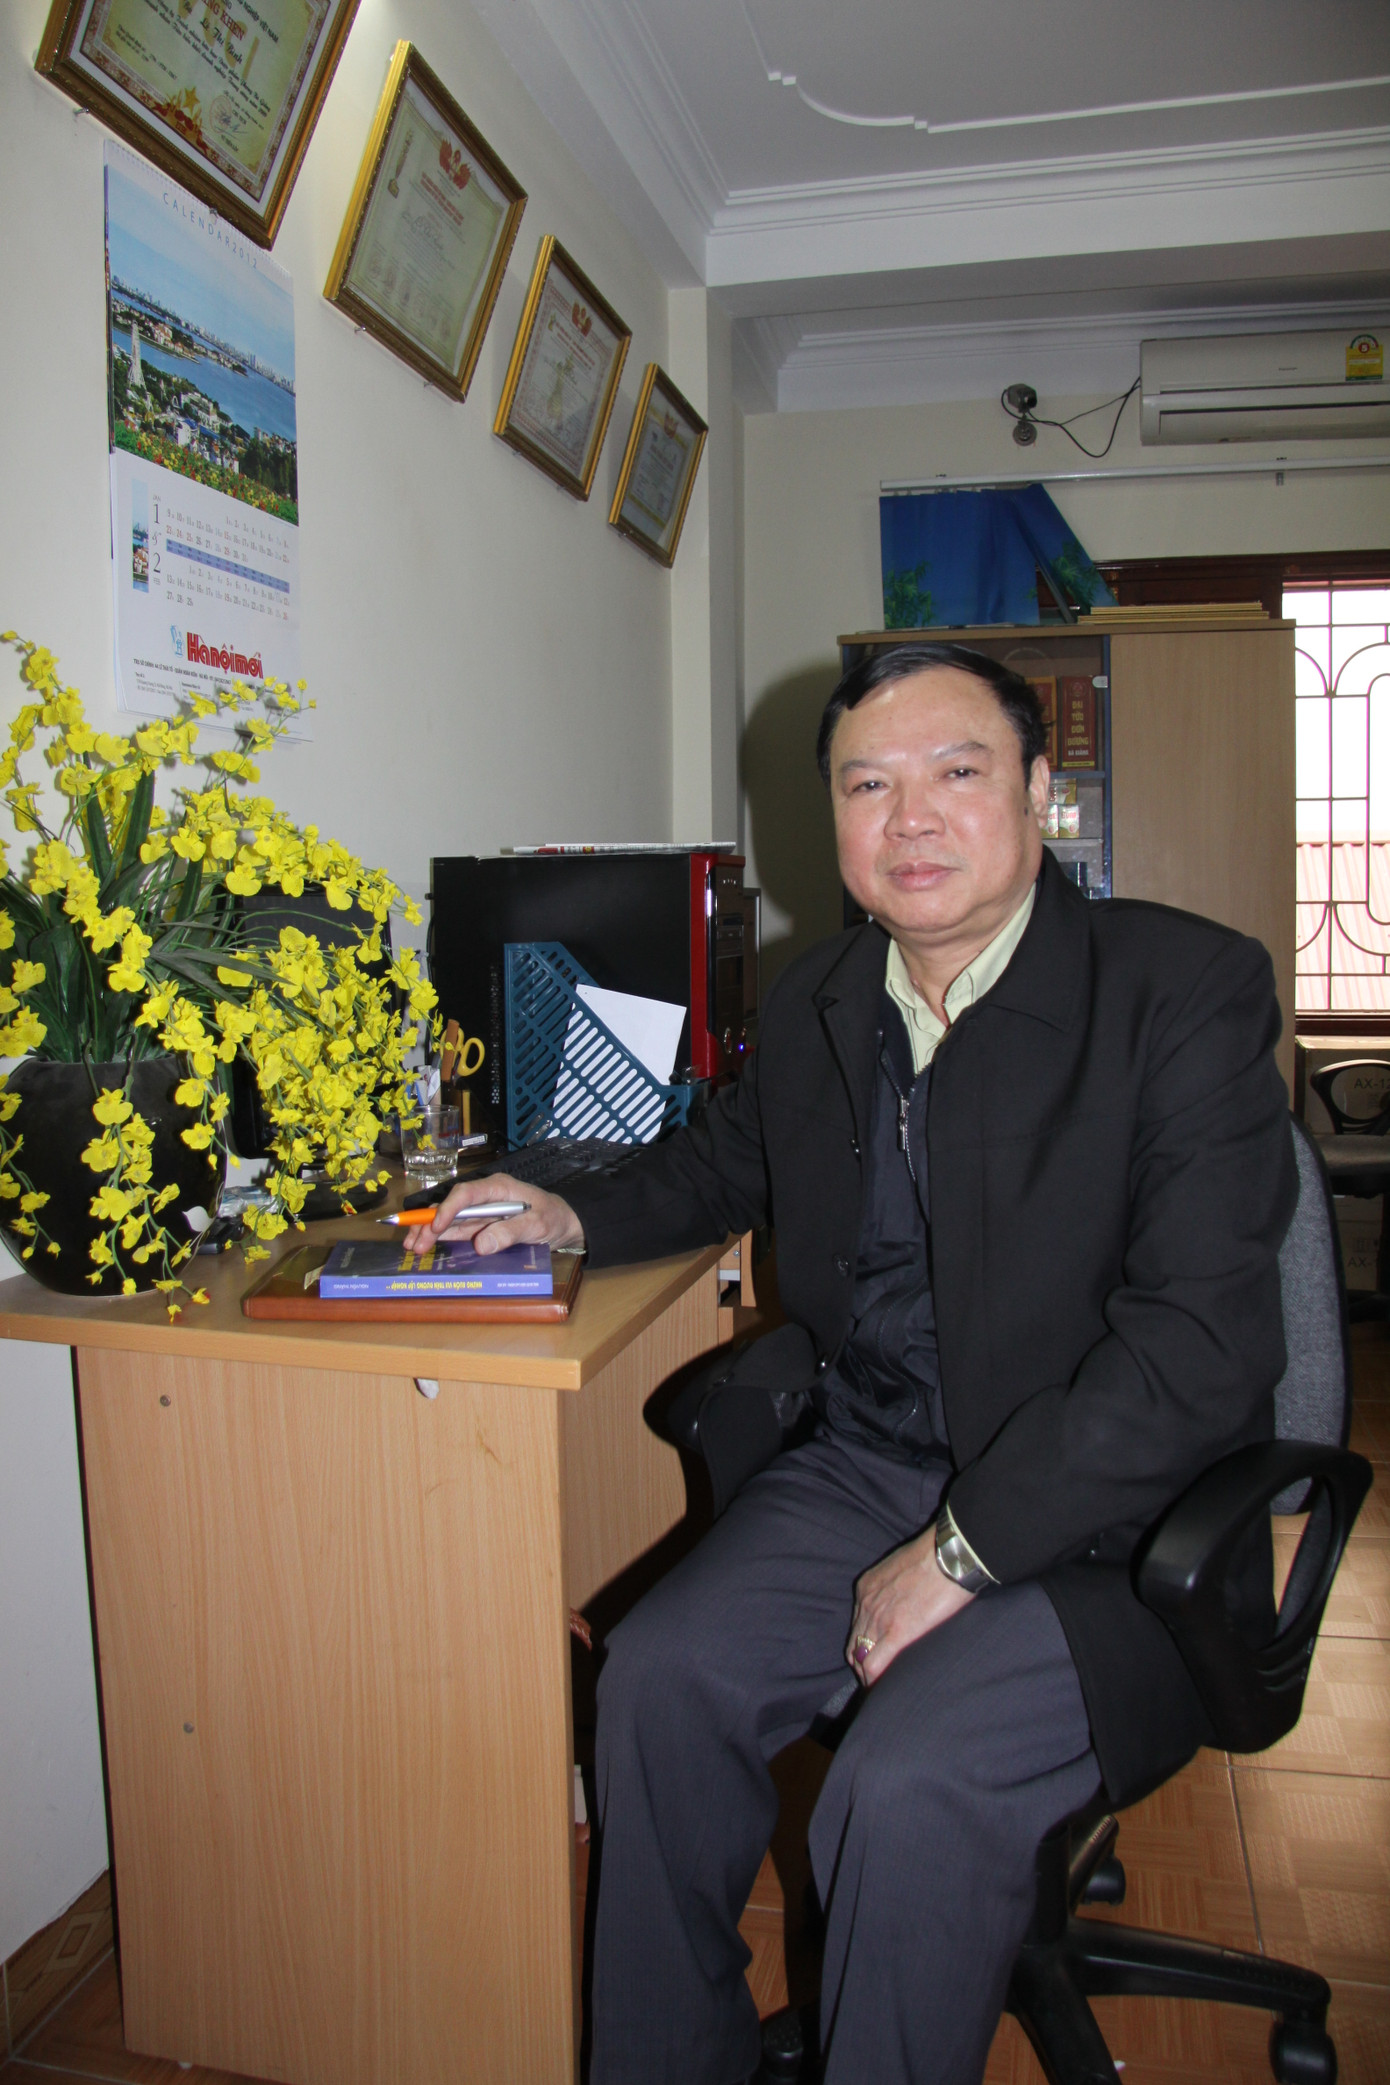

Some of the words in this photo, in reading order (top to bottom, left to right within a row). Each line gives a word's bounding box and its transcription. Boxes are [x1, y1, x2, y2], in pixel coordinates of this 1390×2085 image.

[218, 8, 245, 42] KHEN
[154, 504, 160, 524] 1
[154, 552, 160, 573] 2
